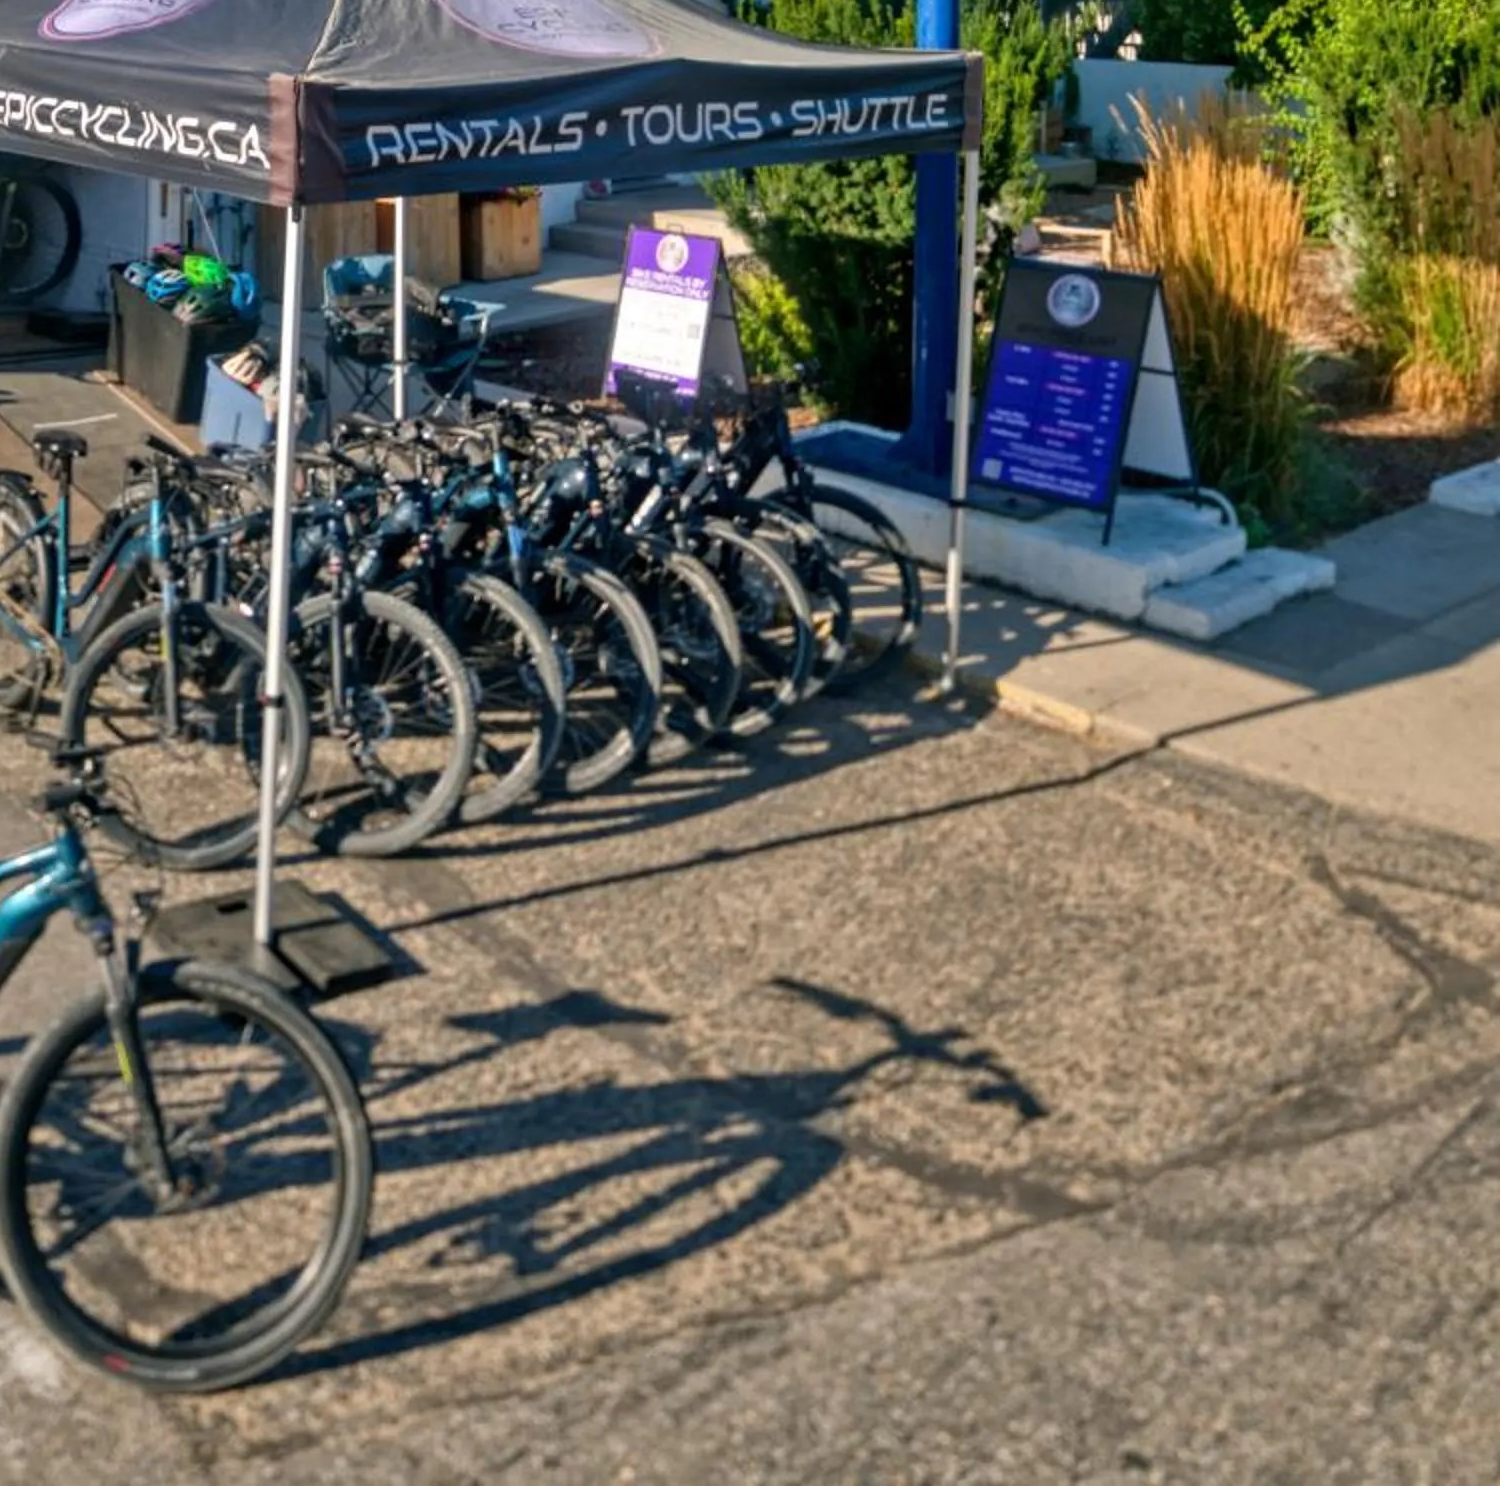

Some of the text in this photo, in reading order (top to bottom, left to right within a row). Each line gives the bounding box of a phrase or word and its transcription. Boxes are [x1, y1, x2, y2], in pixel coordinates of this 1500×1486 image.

[365, 94, 949, 168] RENTALS TOURS SHUTTLE
